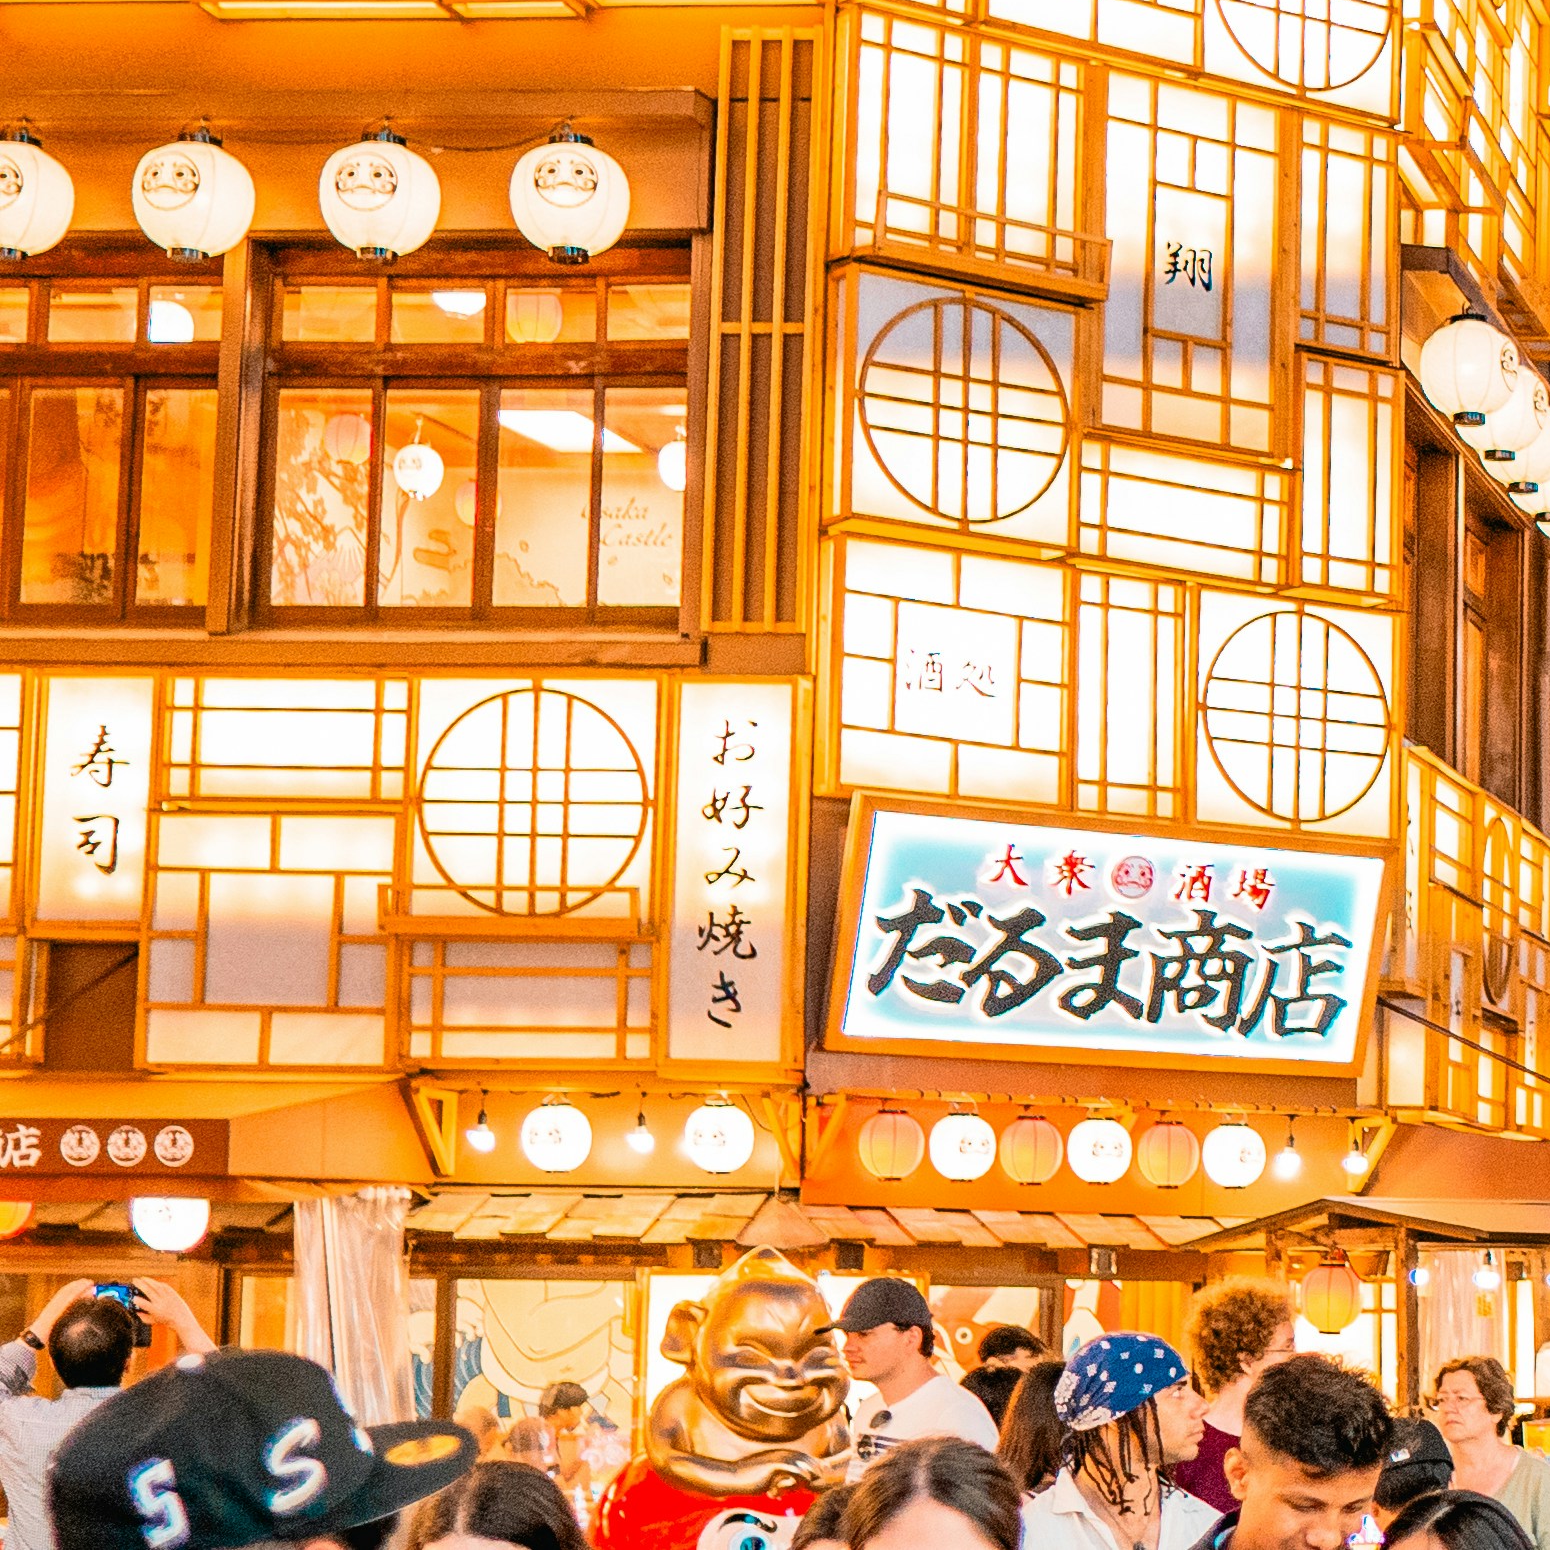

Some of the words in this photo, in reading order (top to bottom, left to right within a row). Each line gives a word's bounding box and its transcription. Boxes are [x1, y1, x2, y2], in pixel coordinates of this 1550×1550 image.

[70, 724, 131, 875] 寿司
[696, 718, 765, 1029] お好み焼き
[983, 844, 1096, 897] 大衆
[1171, 861, 1276, 910] 酒場
[864, 886, 1352, 1039] だるま商店
[0, 1126, 41, 1169] 店
